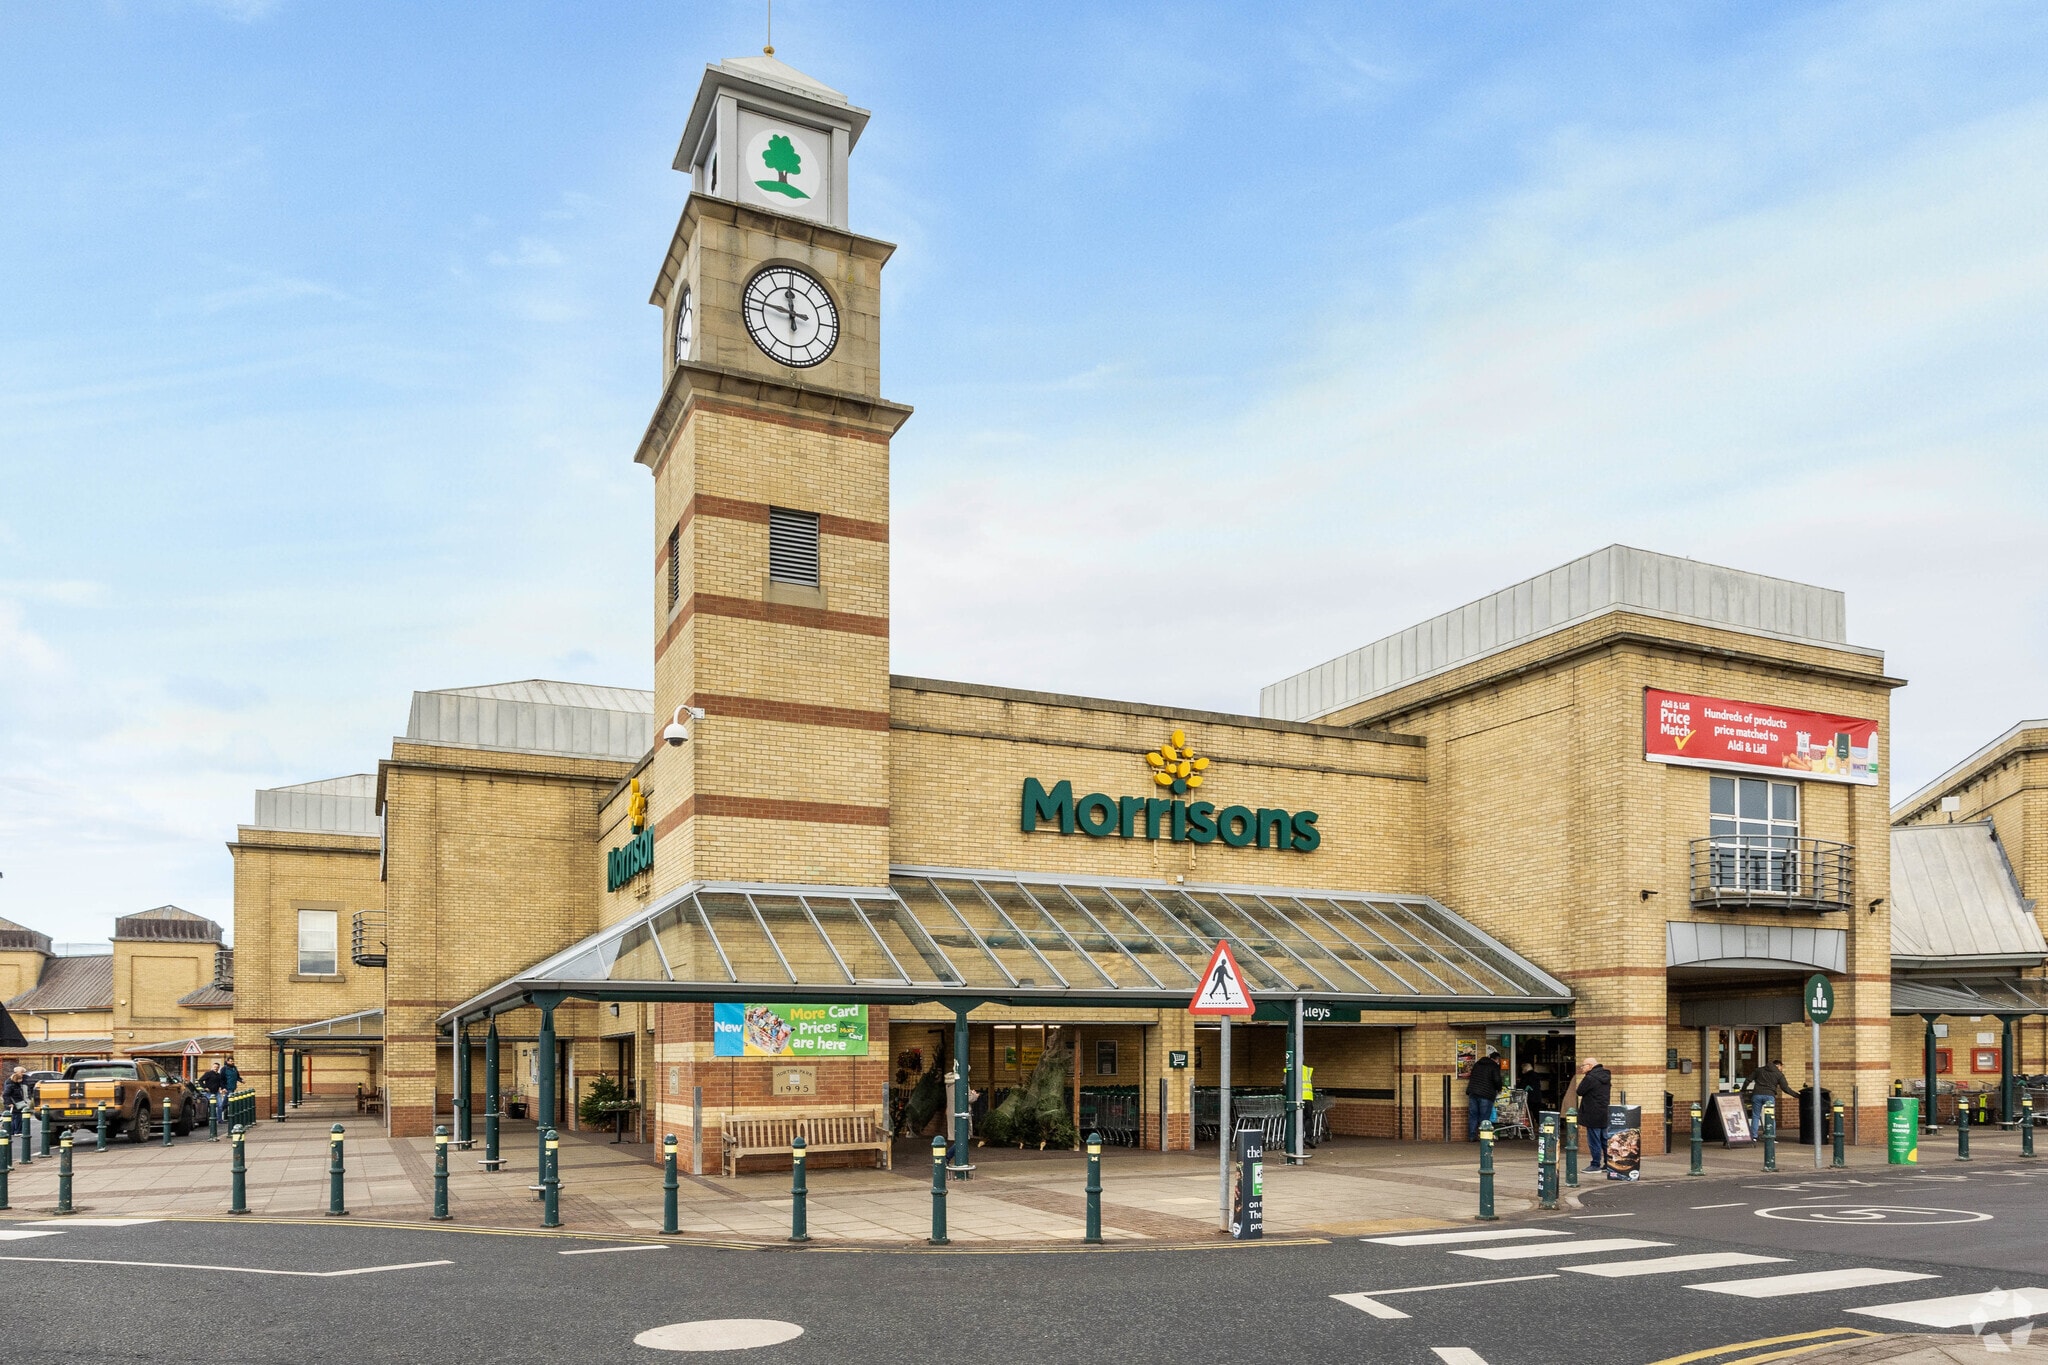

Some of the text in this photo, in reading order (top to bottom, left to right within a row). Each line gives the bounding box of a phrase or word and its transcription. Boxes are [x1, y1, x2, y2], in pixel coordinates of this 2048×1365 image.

[1660, 699, 1690, 710] Aldi & Lidl
[1660, 708, 1691, 725] Price
[1704, 707, 1788, 729] Hundreds of products
[1660, 723, 1691, 736] Match
[1714, 725, 1779, 742] price matched to
[1727, 740, 1767, 754] Aldi & Lidl
[1021, 777, 1321, 851] Morrisons
[790, 1005, 859, 1021] More Card
[714, 1021, 743, 1033] New
[799, 1021, 837, 1035] Prices
[793, 1036, 846, 1050] are here
[848, 1032, 863, 1040] Card
[780, 1084, 809, 1093] 1995
